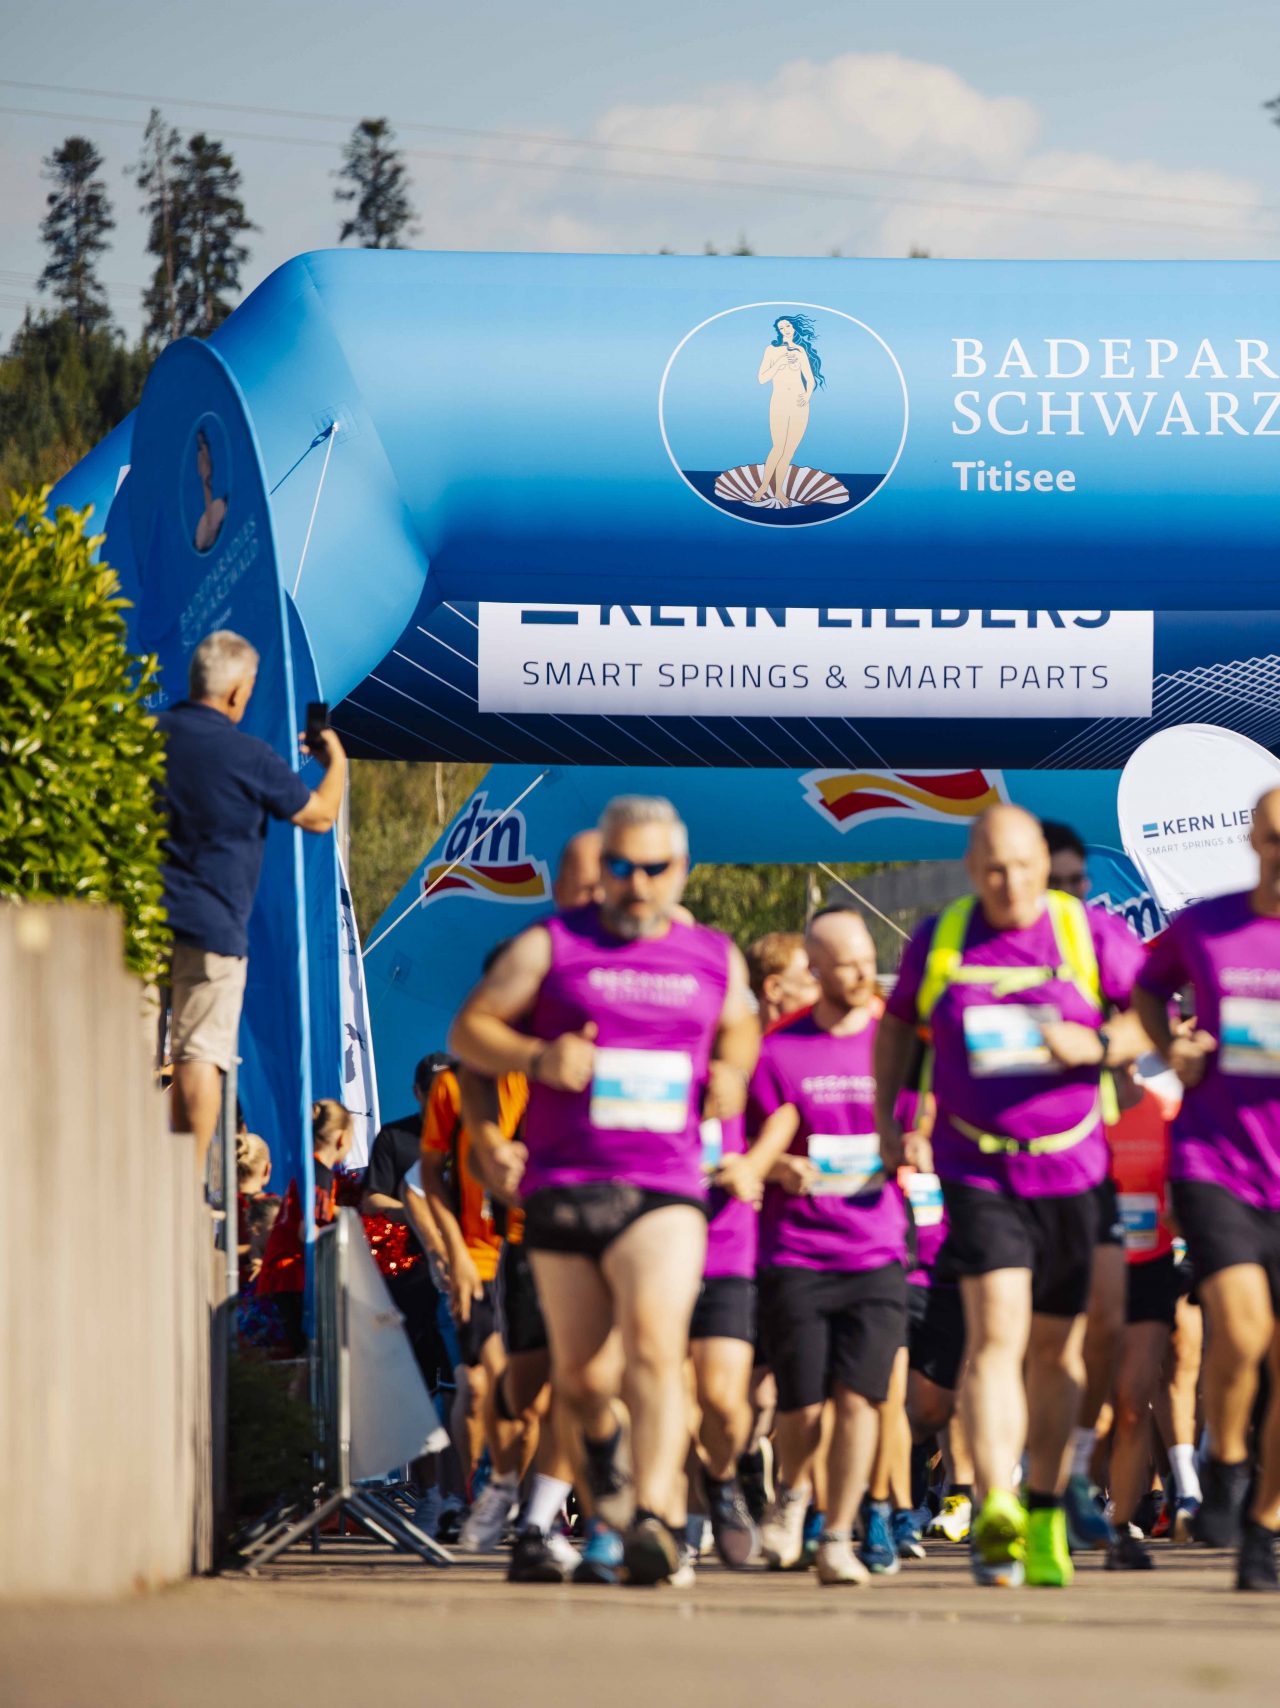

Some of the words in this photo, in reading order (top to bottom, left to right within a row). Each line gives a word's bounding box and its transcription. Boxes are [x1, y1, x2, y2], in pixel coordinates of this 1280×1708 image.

[952, 460, 1077, 493] Titisee
[522, 661, 643, 687] SMART
[658, 664, 810, 689] SPRINGS
[825, 665, 848, 689] &
[864, 665, 984, 689] SMART
[1000, 665, 1109, 689] PARTS
[1163, 814, 1215, 836] KERN
